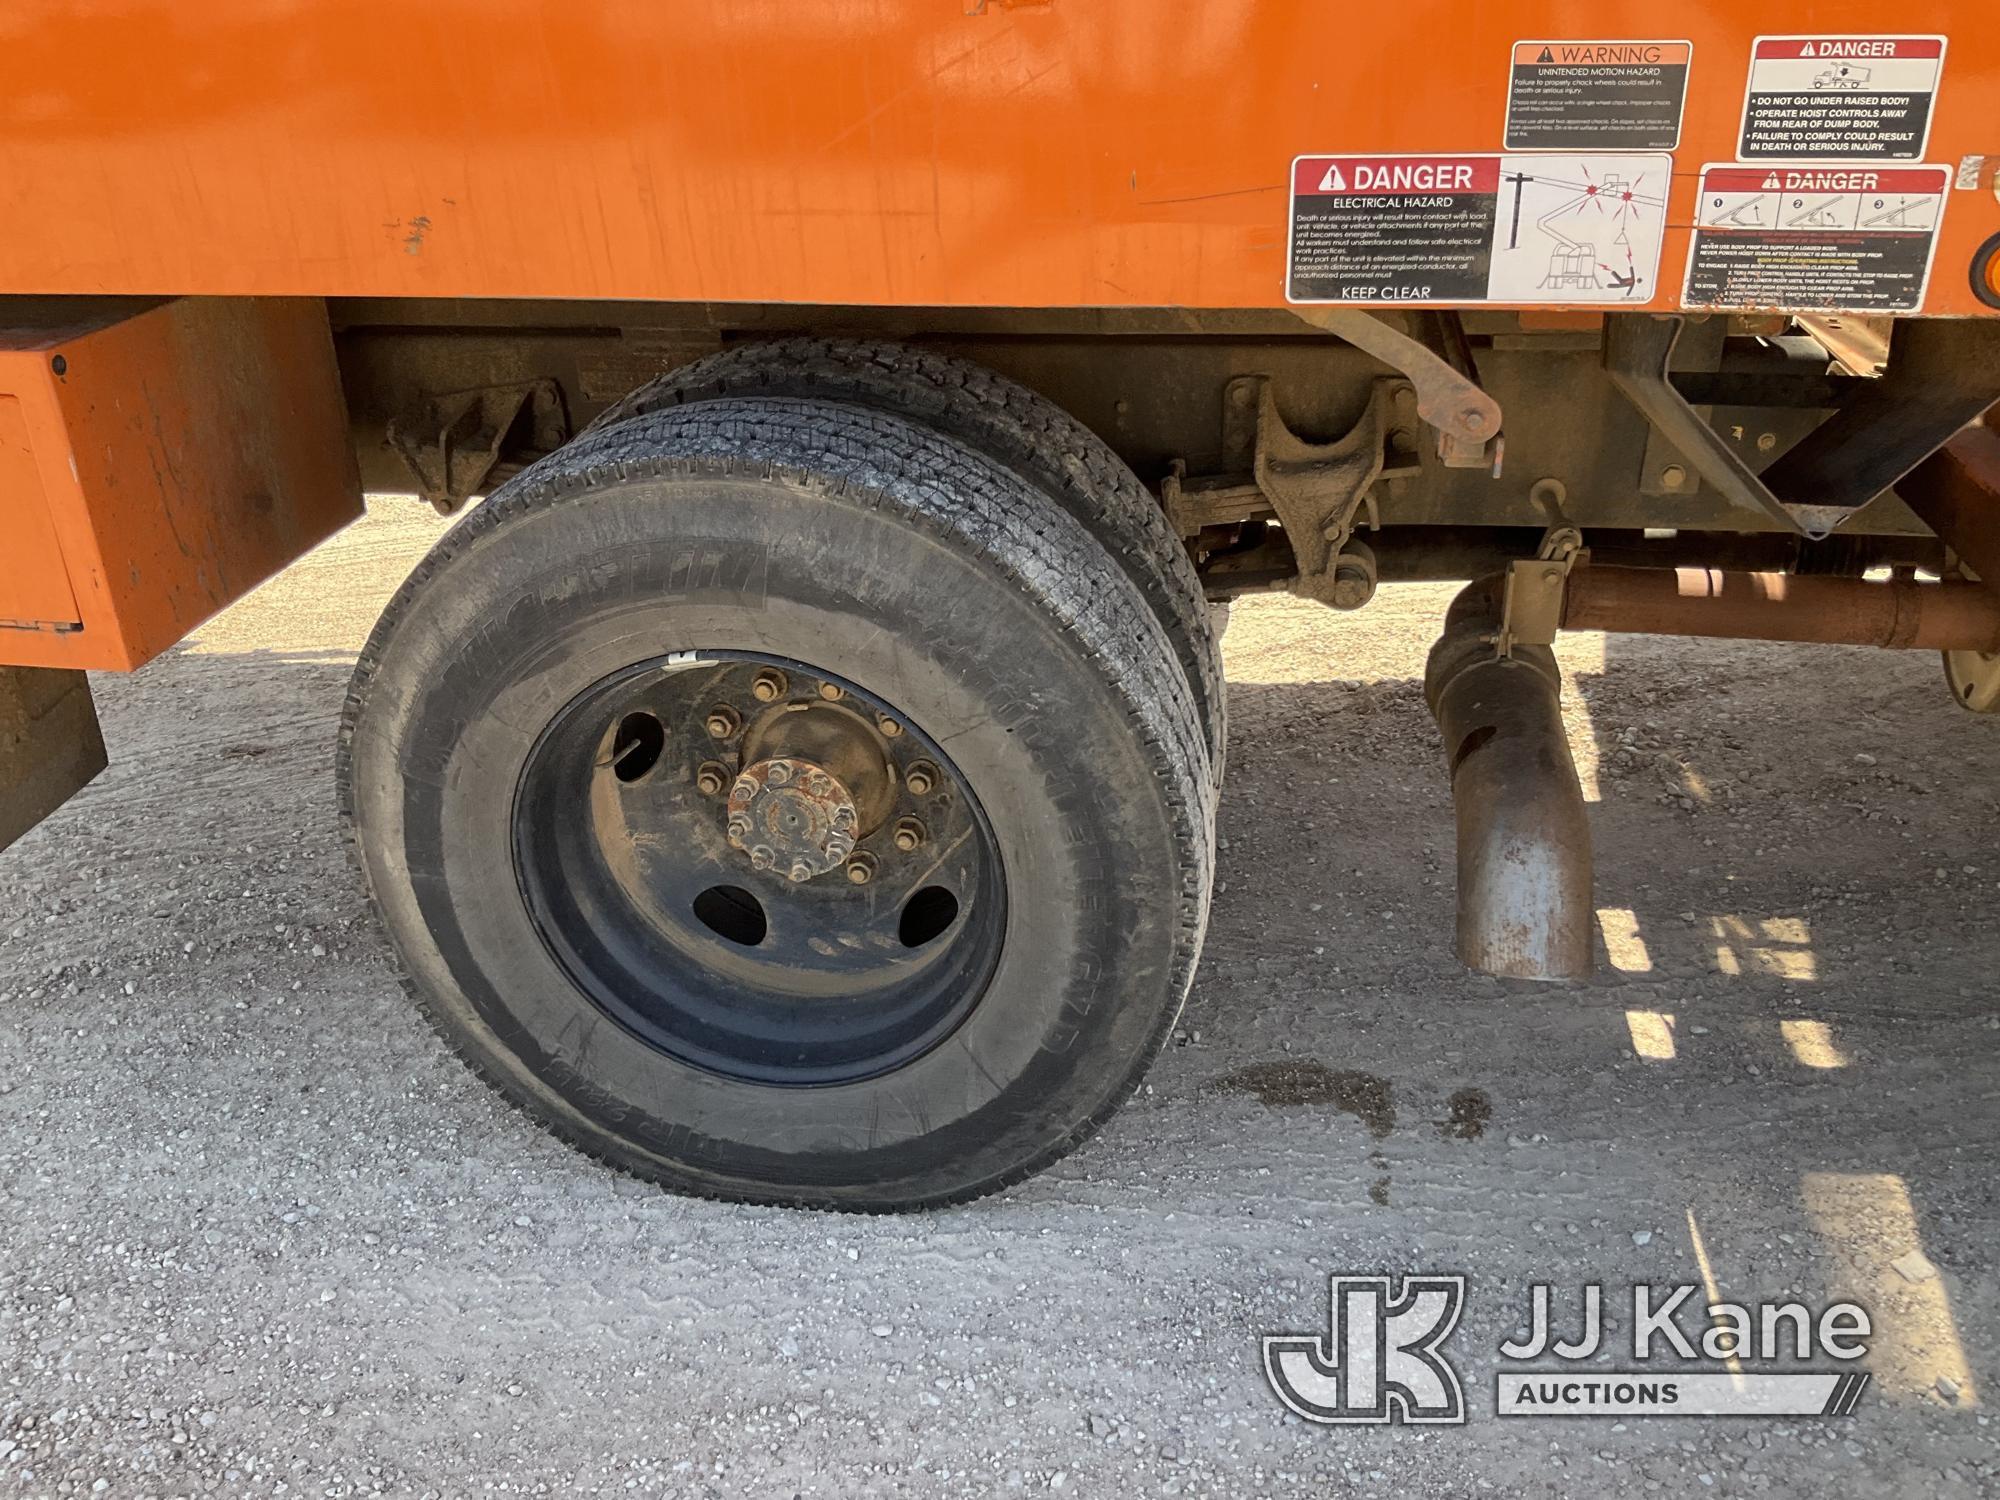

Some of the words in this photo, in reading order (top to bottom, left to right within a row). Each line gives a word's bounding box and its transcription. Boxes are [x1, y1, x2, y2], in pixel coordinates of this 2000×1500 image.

[1818, 42, 1896, 55] DANGER
[1560, 46, 1661, 63] WARNING
[1828, 109, 1879, 117] CONTROLS
[1354, 165, 1473, 189] DANGER
[1785, 173, 1878, 190] DANGER
[1333, 198, 1400, 208] ELECTRICAL
[1403, 197, 1453, 207] HAZARD
[1352, 214, 1370, 222] injury
[1444, 221, 1459, 229] part
[1314, 255, 1329, 263] part
[1294, 263, 1328, 271] approach
[1381, 263, 1416, 271] energized
[1339, 271, 1373, 279] personnel
[1341, 286, 1376, 298] KEEP
[1380, 286, 1430, 298] CLEAR
